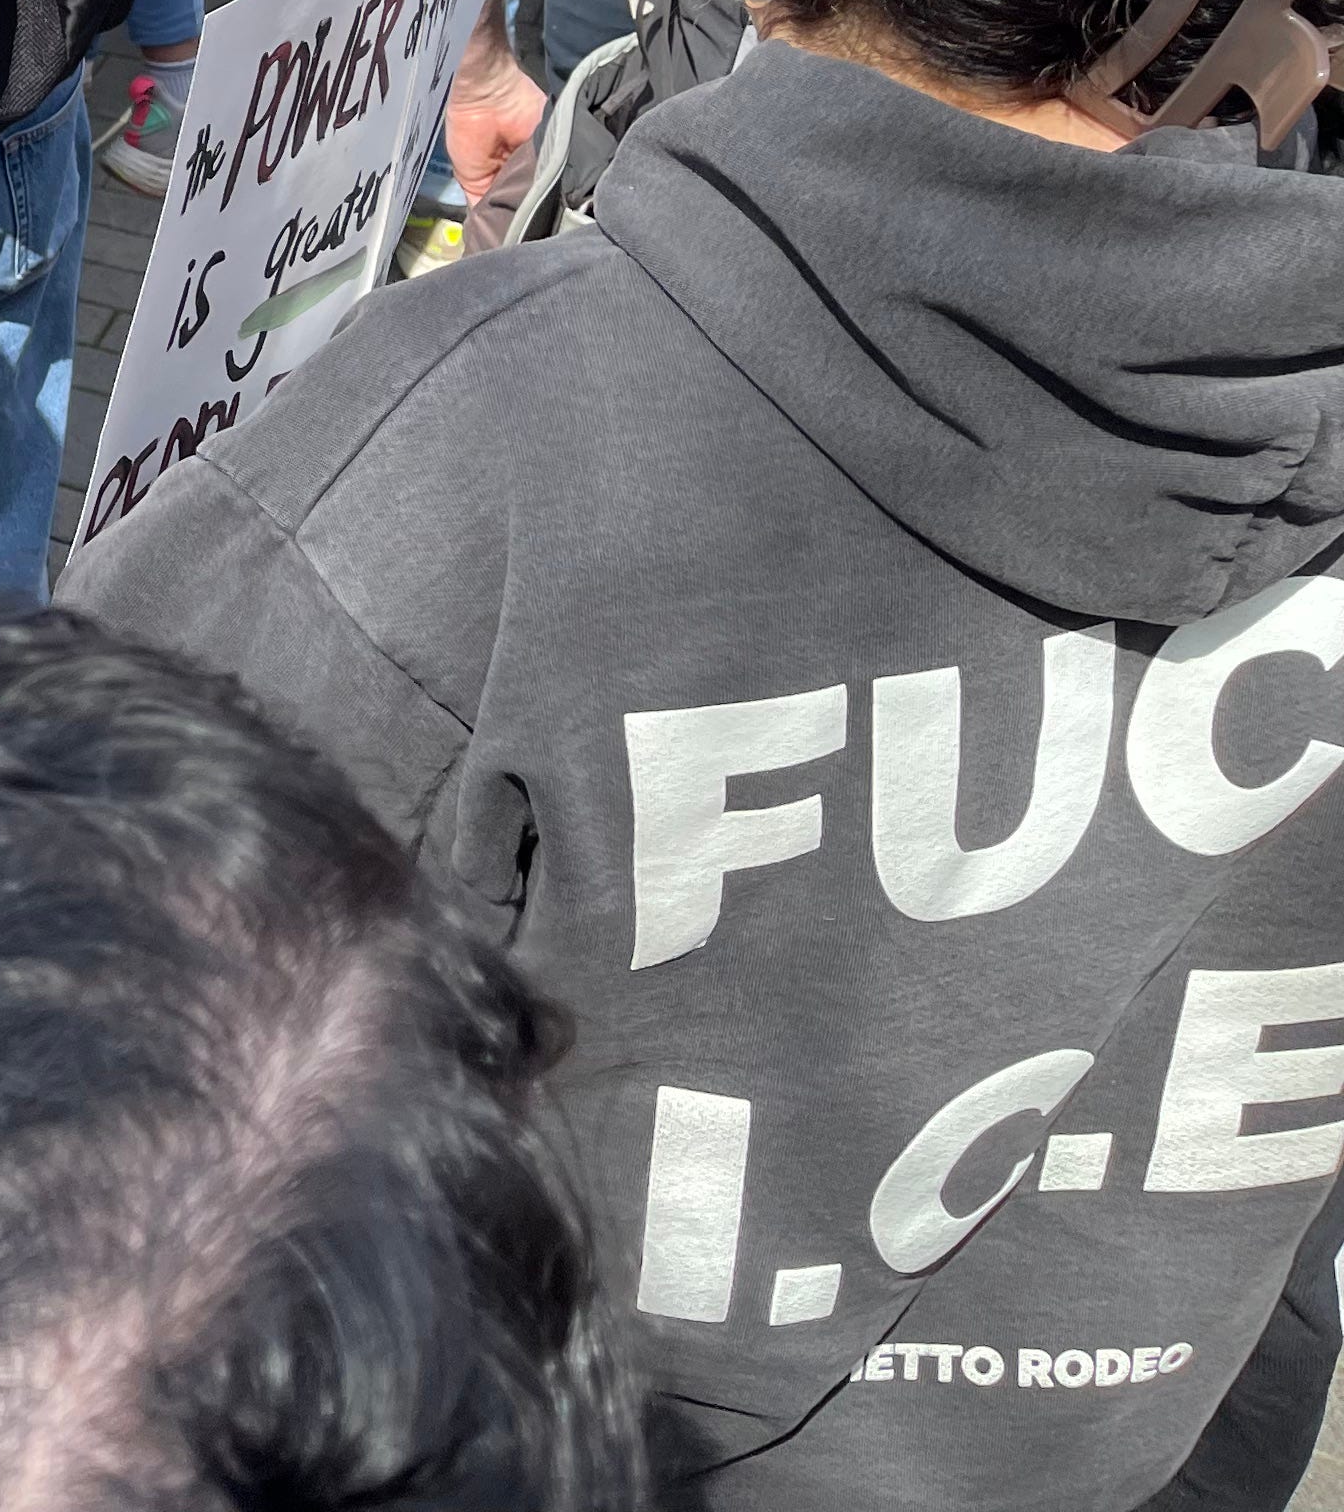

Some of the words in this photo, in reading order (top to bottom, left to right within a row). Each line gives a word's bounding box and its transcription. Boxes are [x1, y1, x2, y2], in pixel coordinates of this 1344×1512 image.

[180, 124, 226, 215] the
[166, 250, 226, 352] is
[225, 162, 393, 383] greater
[1018, 1342, 1194, 1389] RODEO
